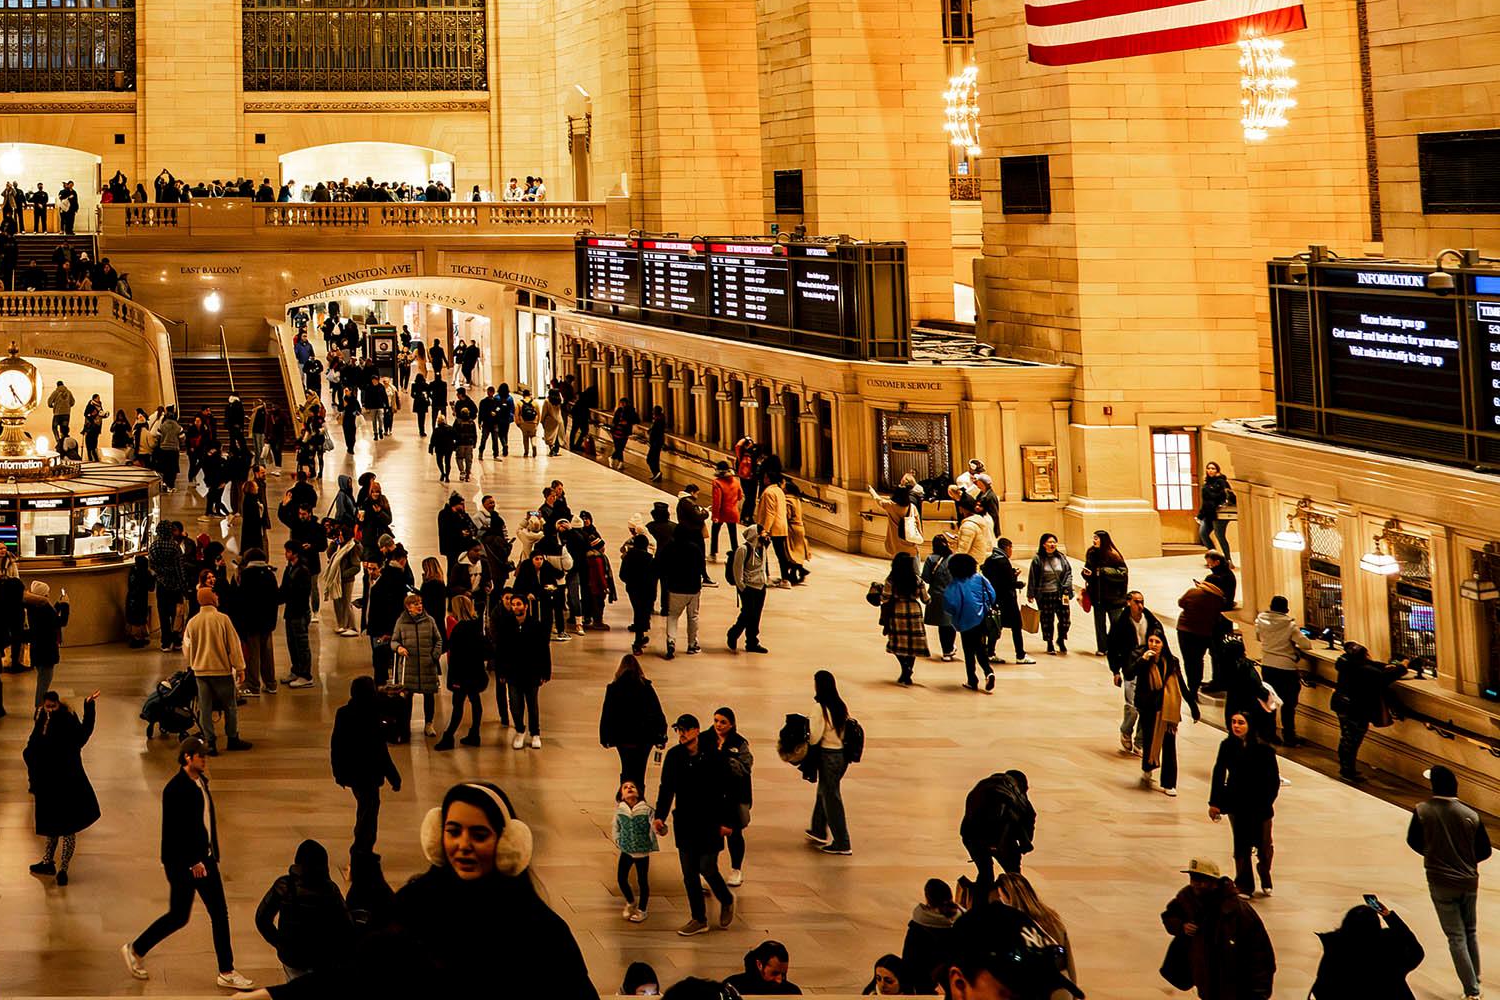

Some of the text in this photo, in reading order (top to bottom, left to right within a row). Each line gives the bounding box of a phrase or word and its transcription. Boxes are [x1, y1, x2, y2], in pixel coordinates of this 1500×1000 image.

[180, 266, 241, 274] EAST BALCONY
[322, 264, 411, 287] LEXINGTON AVE
[451, 264, 549, 289] TICKET MACHINES
[1357, 272, 1424, 287] INFORMATION
[338, 287, 378, 298] PASSAGE
[382, 288, 422, 299] SUBWAY
[1360, 314, 1427, 331] Know before you go
[1332, 327, 1459, 349] Get email and text alerts for your routes
[34, 348, 63, 357] DINING
[1349, 345, 1364, 357] Visit
[1408, 352, 1417, 362] to
[1416, 353, 1432, 365] sign
[1432, 356, 1445, 367] up
[866, 379, 944, 391] CUSTOMER SERVICE
